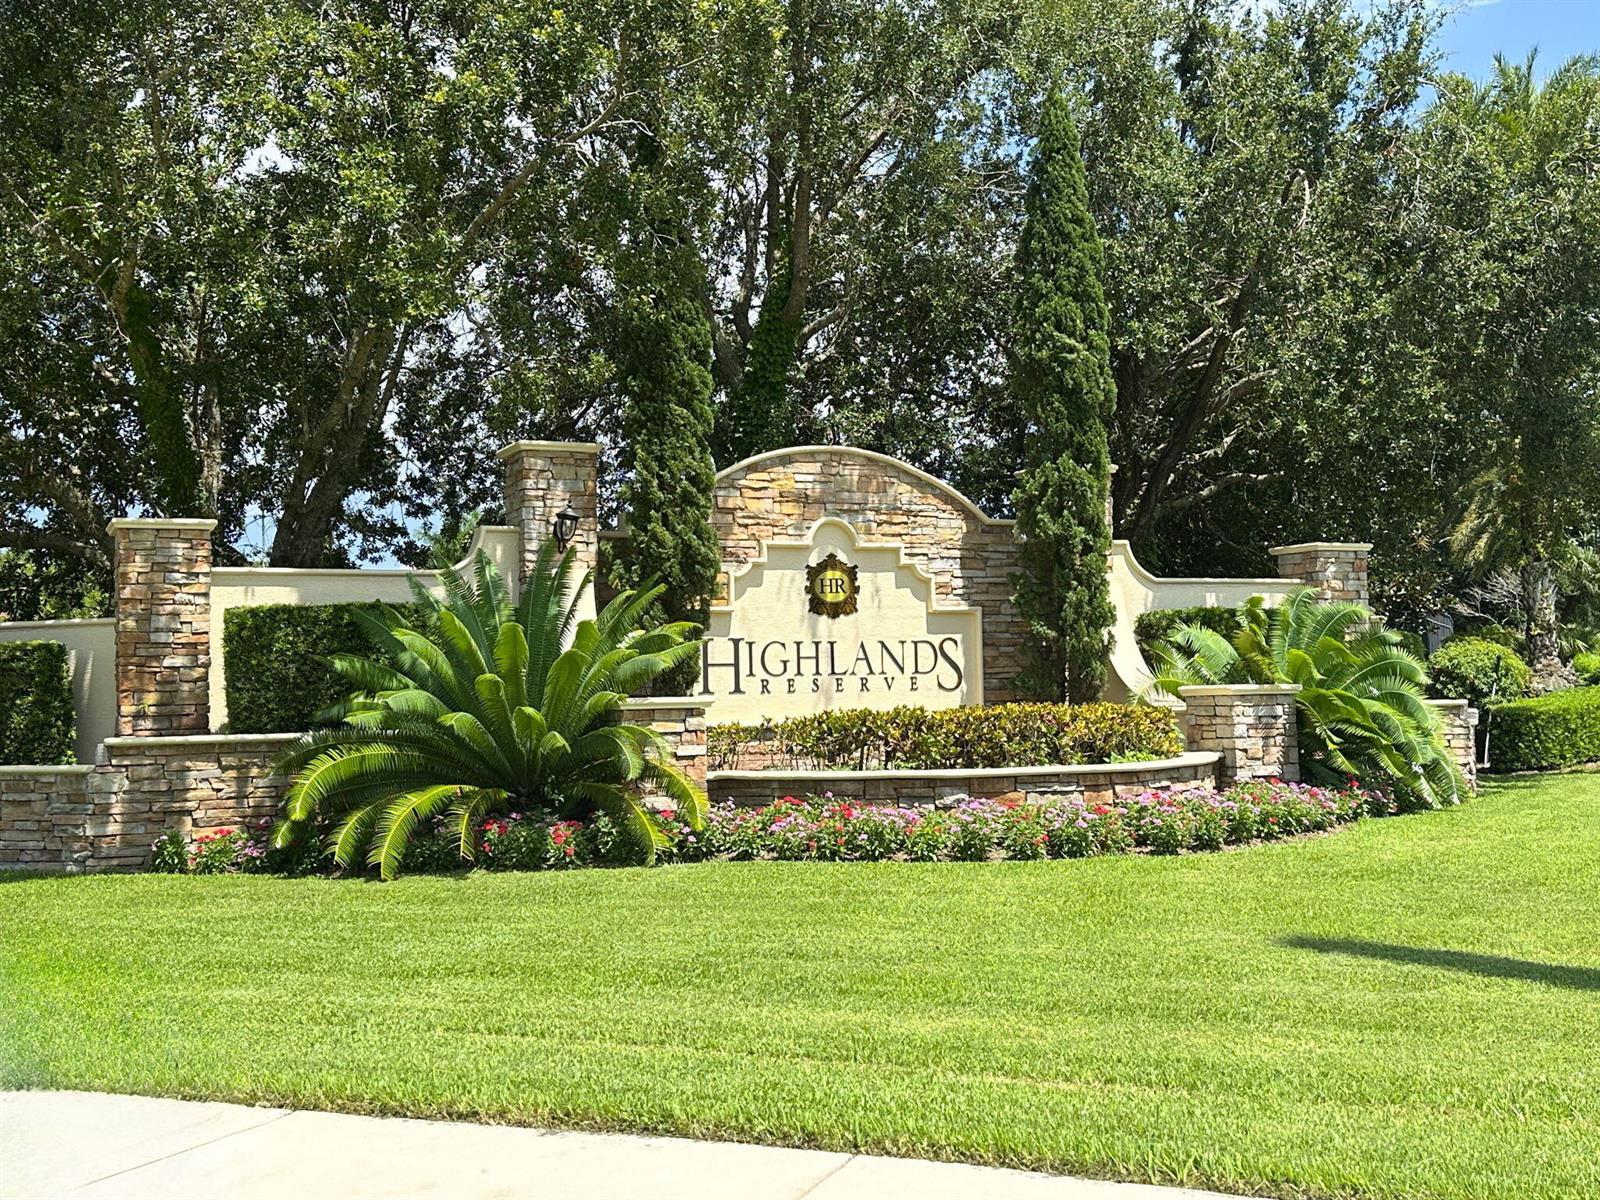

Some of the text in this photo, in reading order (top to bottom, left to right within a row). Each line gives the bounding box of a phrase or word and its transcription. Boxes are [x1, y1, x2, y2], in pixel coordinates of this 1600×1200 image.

[818, 578, 846, 594] HR
[698, 637, 963, 695] HIGHLANDS
[760, 676, 919, 694] RESERVE
